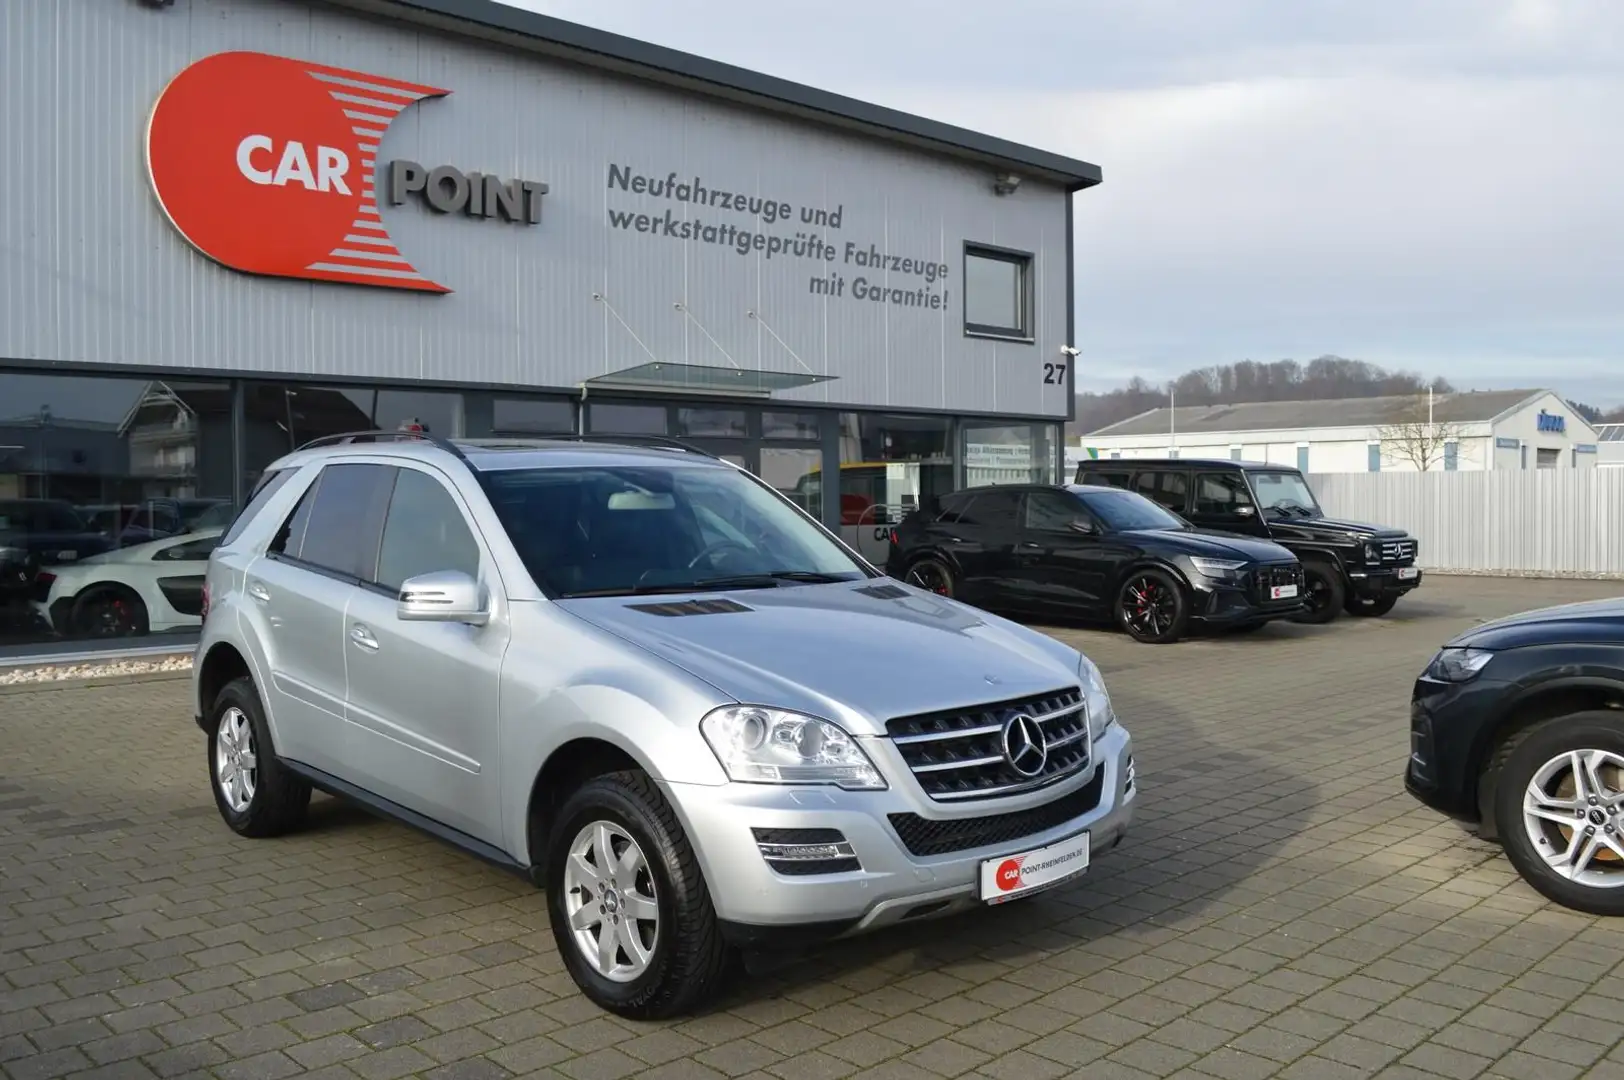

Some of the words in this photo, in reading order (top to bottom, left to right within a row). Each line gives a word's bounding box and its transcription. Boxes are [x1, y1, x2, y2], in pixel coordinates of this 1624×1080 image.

[236, 134, 352, 196] CAR
[391, 160, 550, 224] POINT
[607, 163, 792, 224] Neufahrzeuge
[800, 205, 844, 229] und
[608, 209, 837, 262] werkstattgeprüfte
[844, 241, 949, 283] Fahrzeuge
[809, 272, 845, 297] mit
[852, 277, 949, 311] Garantie!
[1043, 363, 1067, 385] 27
[1004, 869, 1019, 881] CAR
